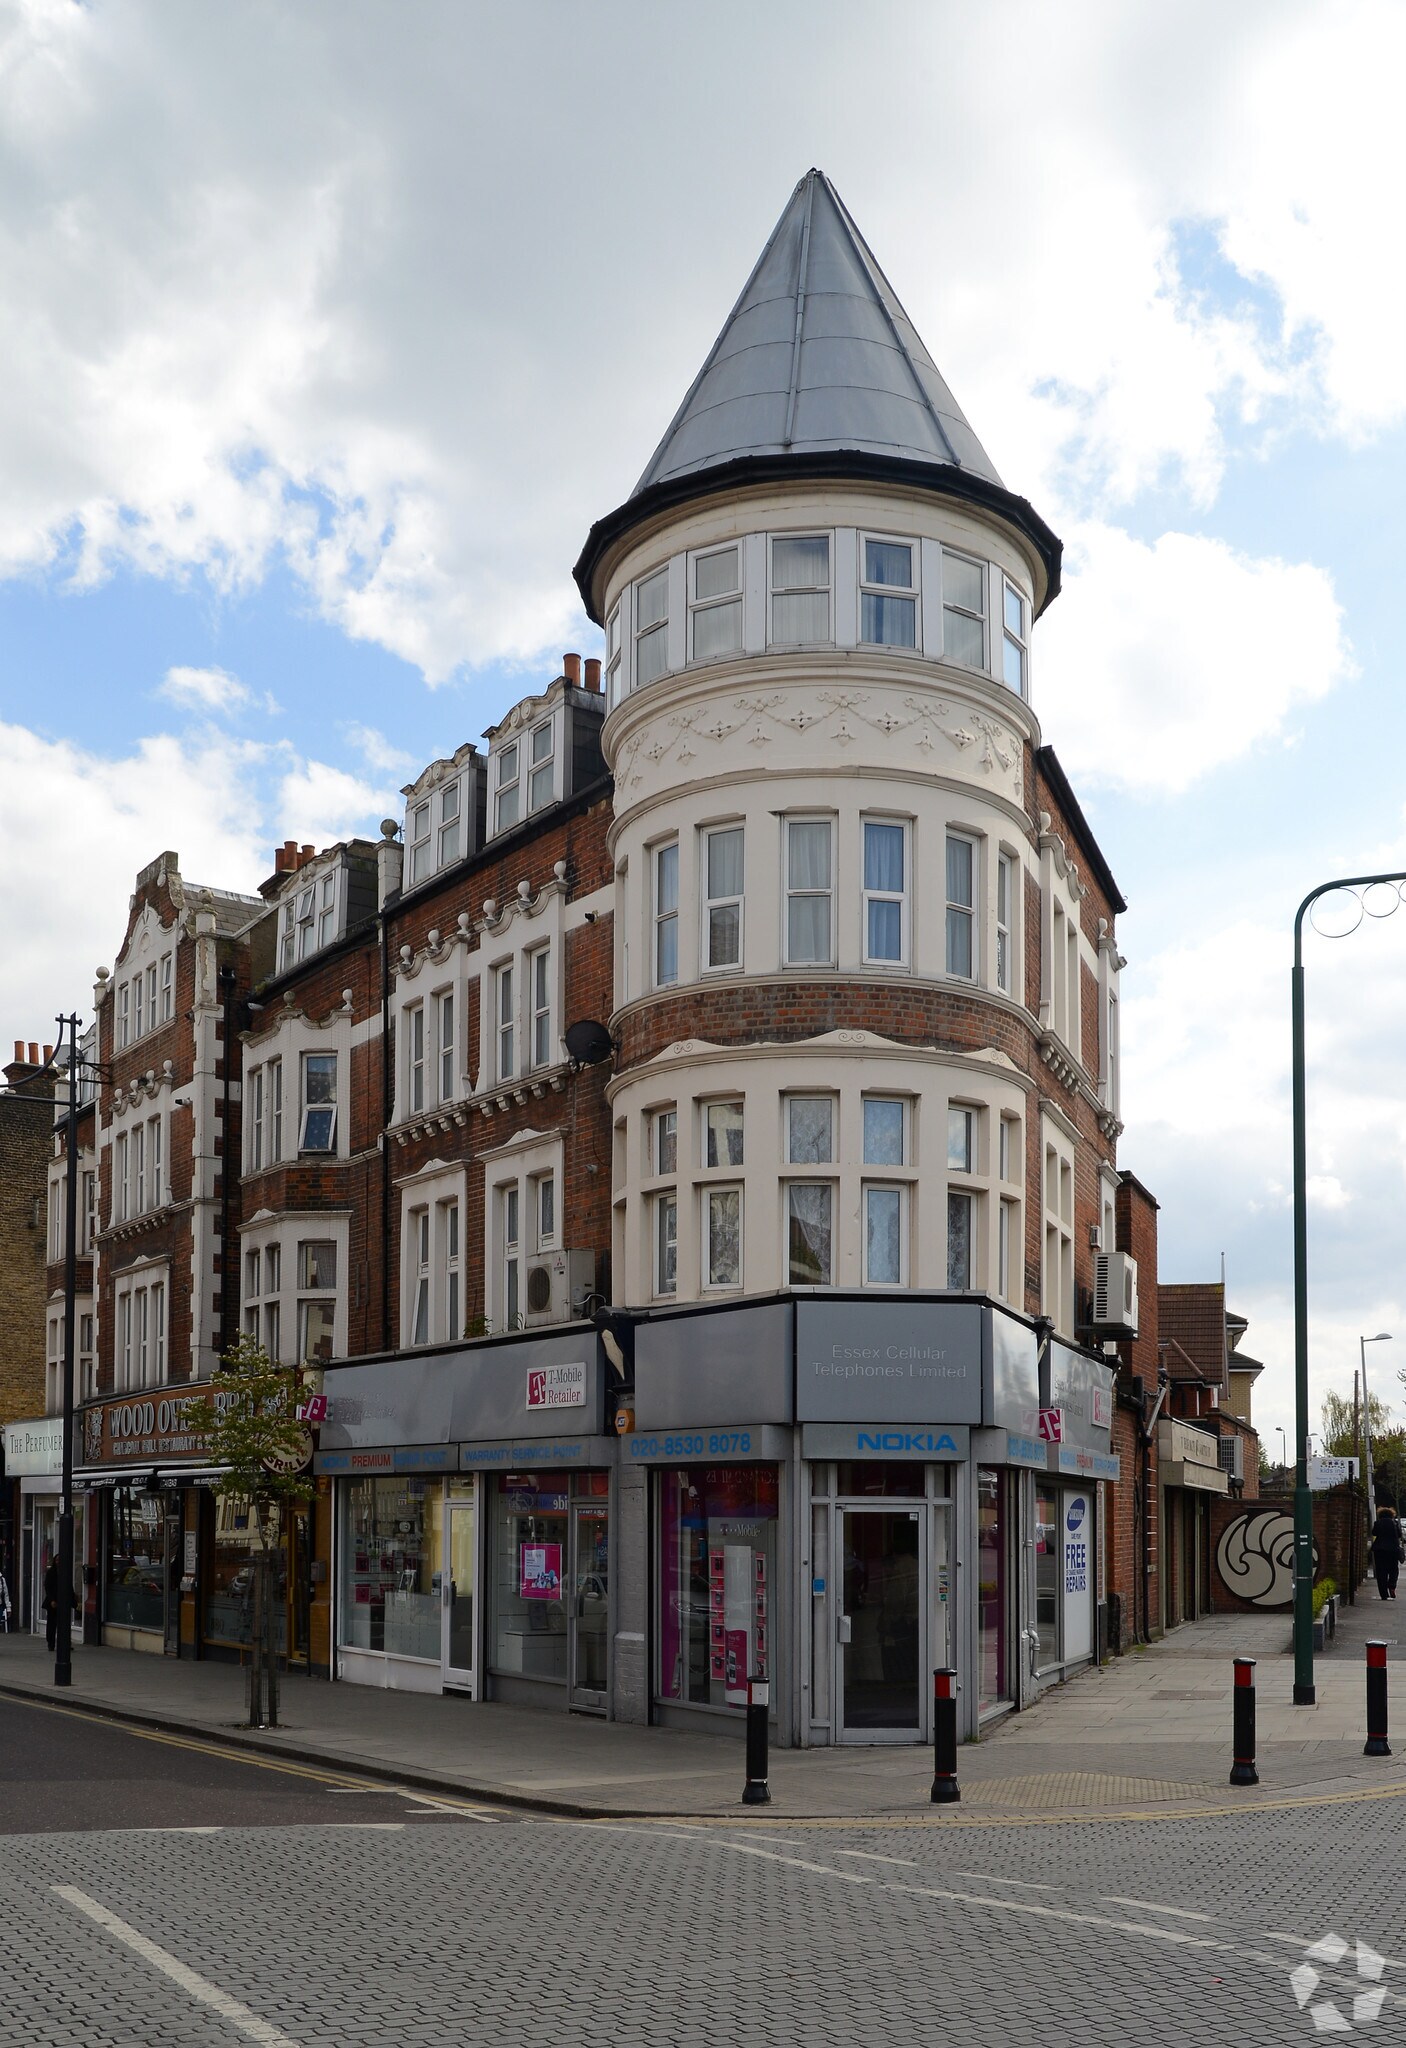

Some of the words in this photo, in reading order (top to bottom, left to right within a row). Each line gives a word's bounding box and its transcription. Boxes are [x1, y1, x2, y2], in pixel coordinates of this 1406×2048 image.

[832, 1344, 881, 1359] Essex
[886, 1345, 947, 1360] Cellular
[548, 1368, 582, 1385] T-Mobile
[812, 1362, 904, 1379] Telephones
[909, 1364, 967, 1378] Limited
[548, 1389, 581, 1404] Retailer
[109, 1401, 155, 1438] WOOD
[157, 1395, 206, 1433] OVE
[631, 1435, 704, 1457] 020-8530
[709, 1433, 751, 1453] 8078
[858, 1433, 958, 1451] NOKIA
[352, 1454, 391, 1468] PREMIUM
[464, 1448, 509, 1462] WARRANTY
[512, 1447, 551, 1460] SERVICE
[553, 1445, 582, 1458] POINT
[1066, 1544, 1086, 1570] FREE
[1066, 1576, 1086, 1594] REPAIRS
